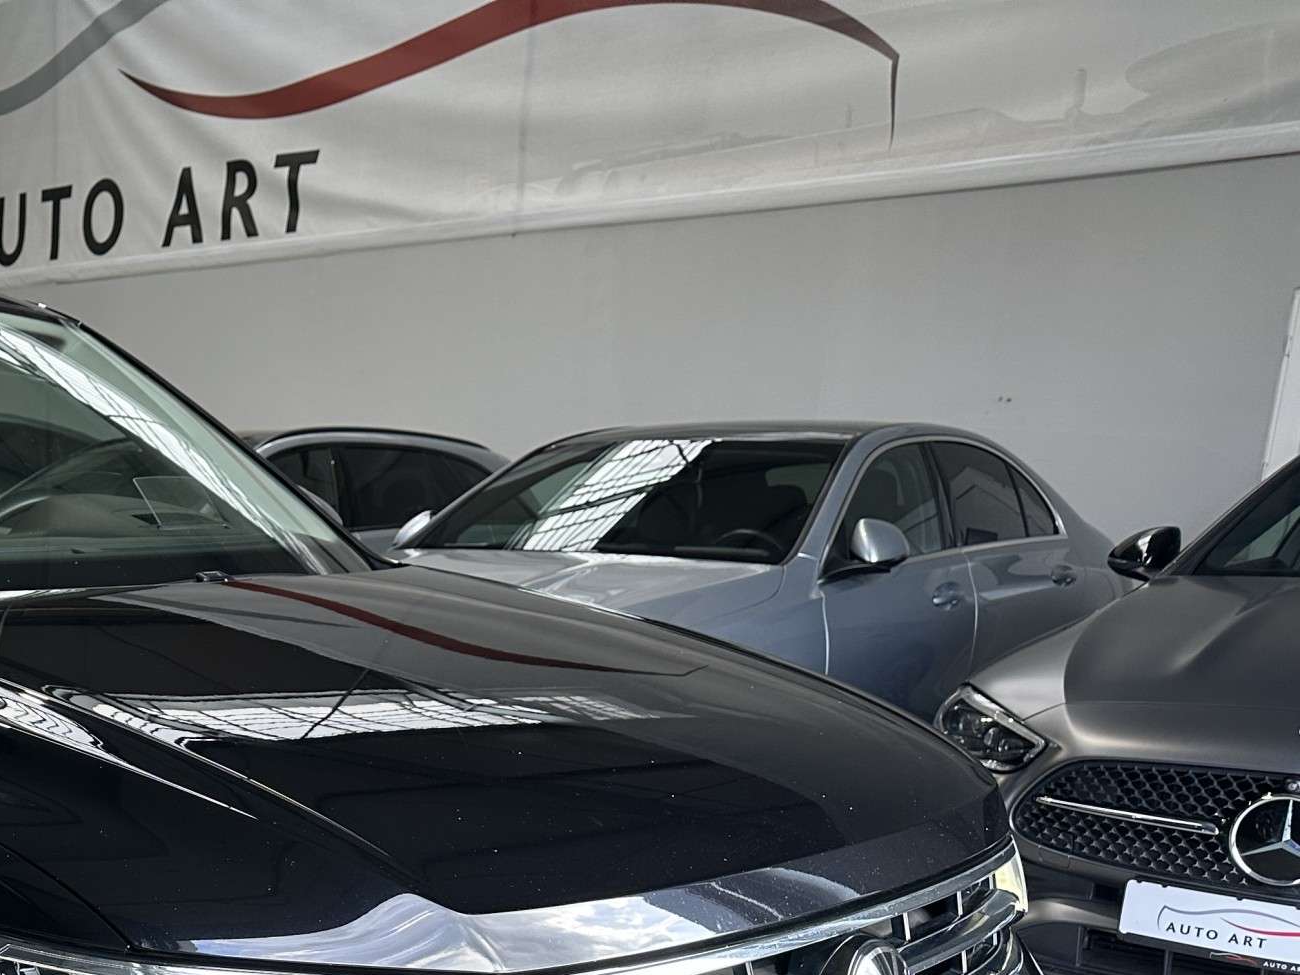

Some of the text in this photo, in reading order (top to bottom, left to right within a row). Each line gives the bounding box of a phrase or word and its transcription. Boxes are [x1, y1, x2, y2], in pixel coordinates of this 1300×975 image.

[161, 149, 320, 248] ART
[1165, 921, 1268, 949] AUTO ART
[1262, 960, 1288, 970] AUTO
